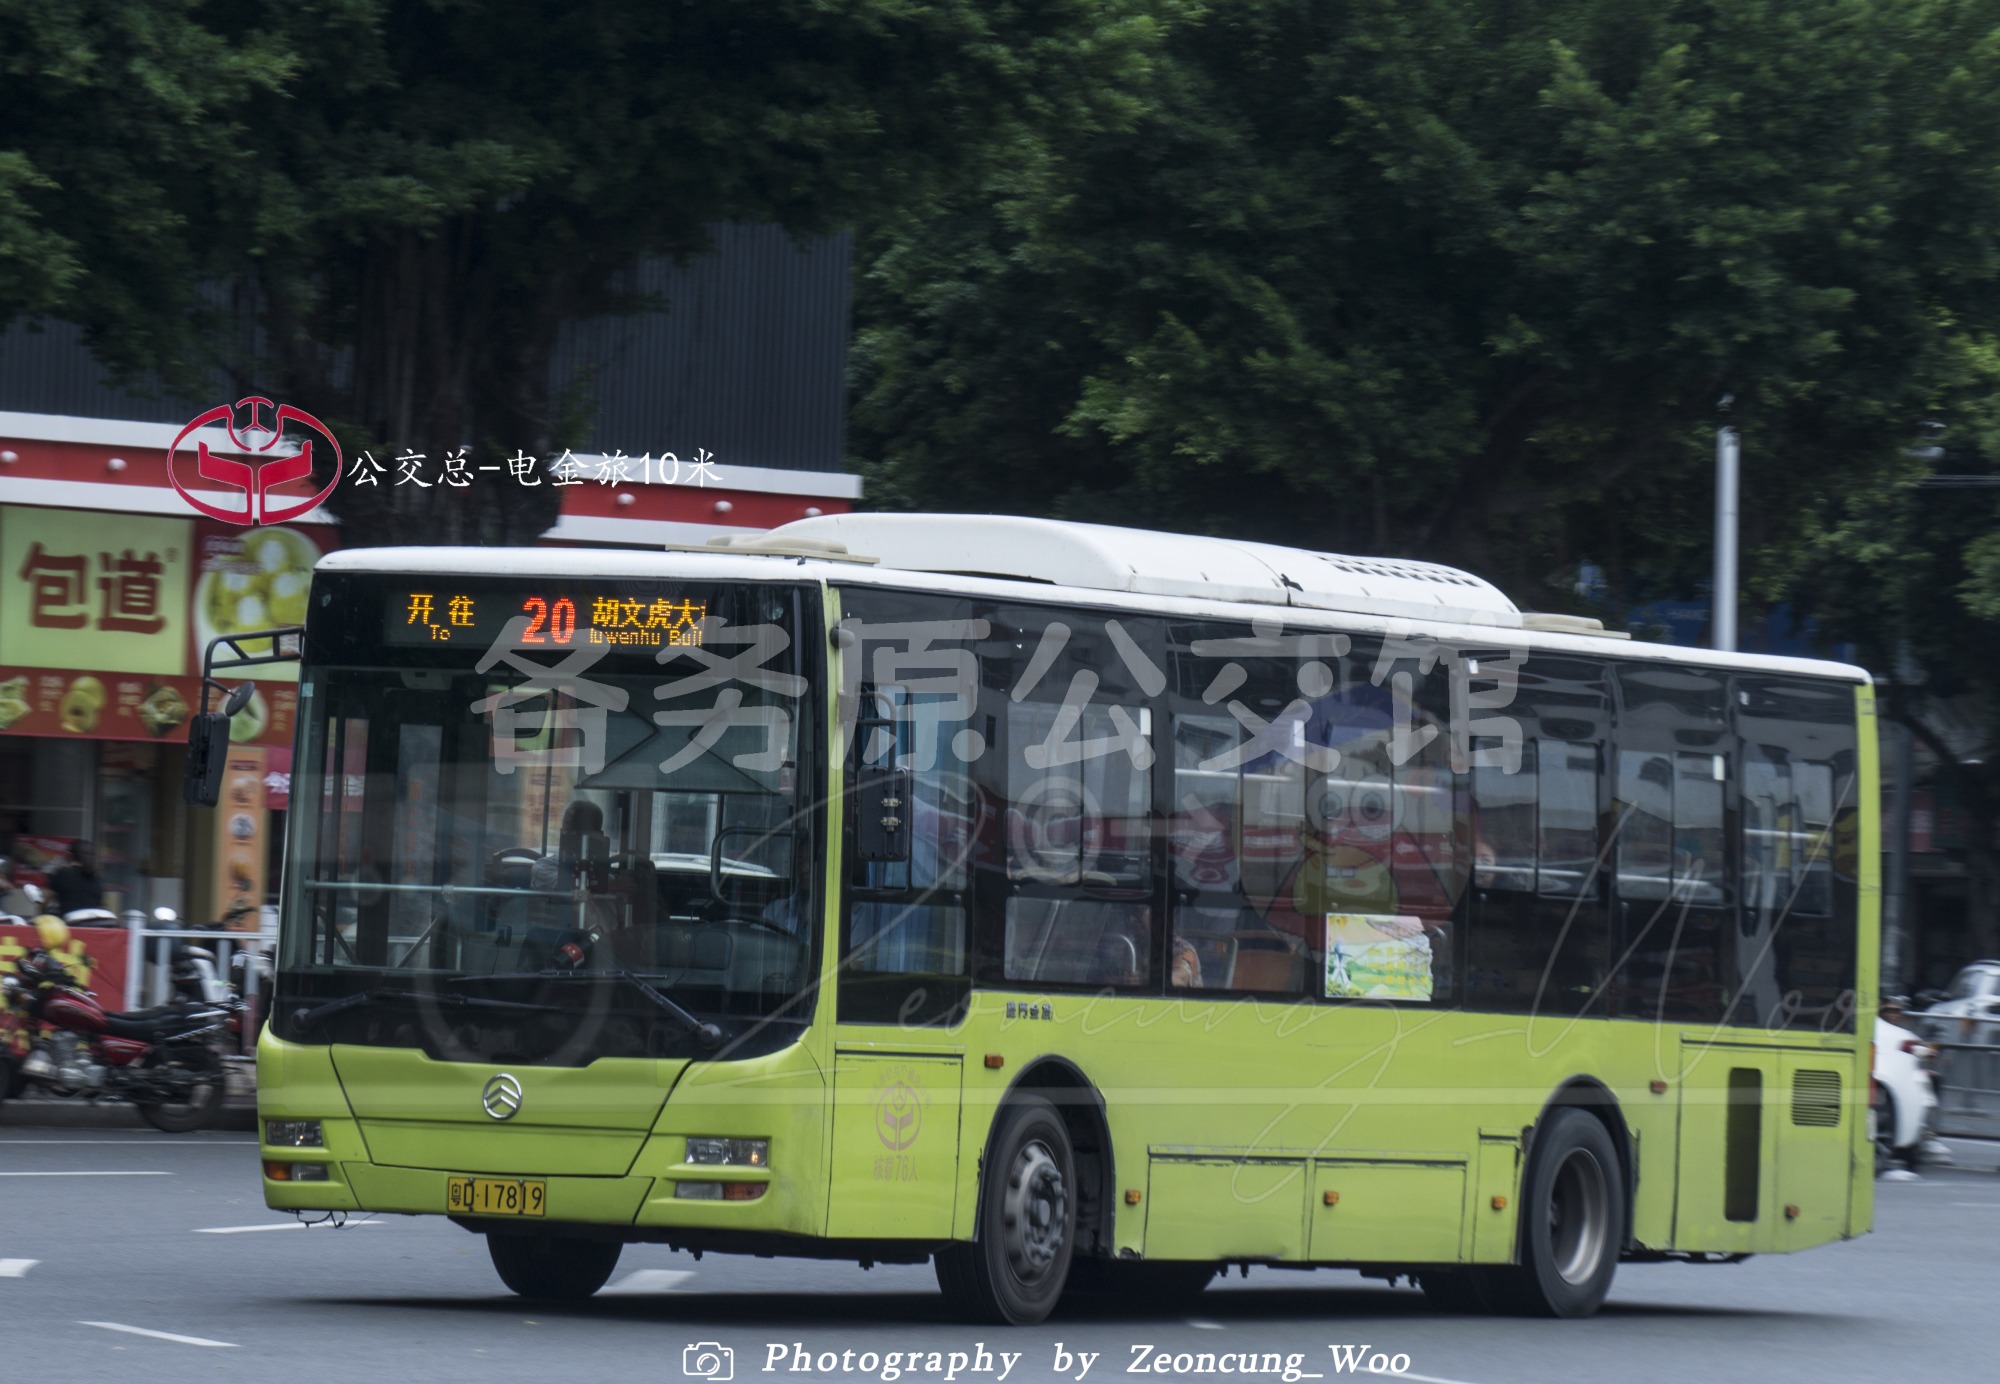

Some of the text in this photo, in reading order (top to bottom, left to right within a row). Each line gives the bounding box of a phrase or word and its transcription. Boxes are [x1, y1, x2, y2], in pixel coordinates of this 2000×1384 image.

[19, 541, 167, 635] 包道
[407, 593, 707, 644] 开往 20 胡文虎大
[430, 624, 451, 640] To
